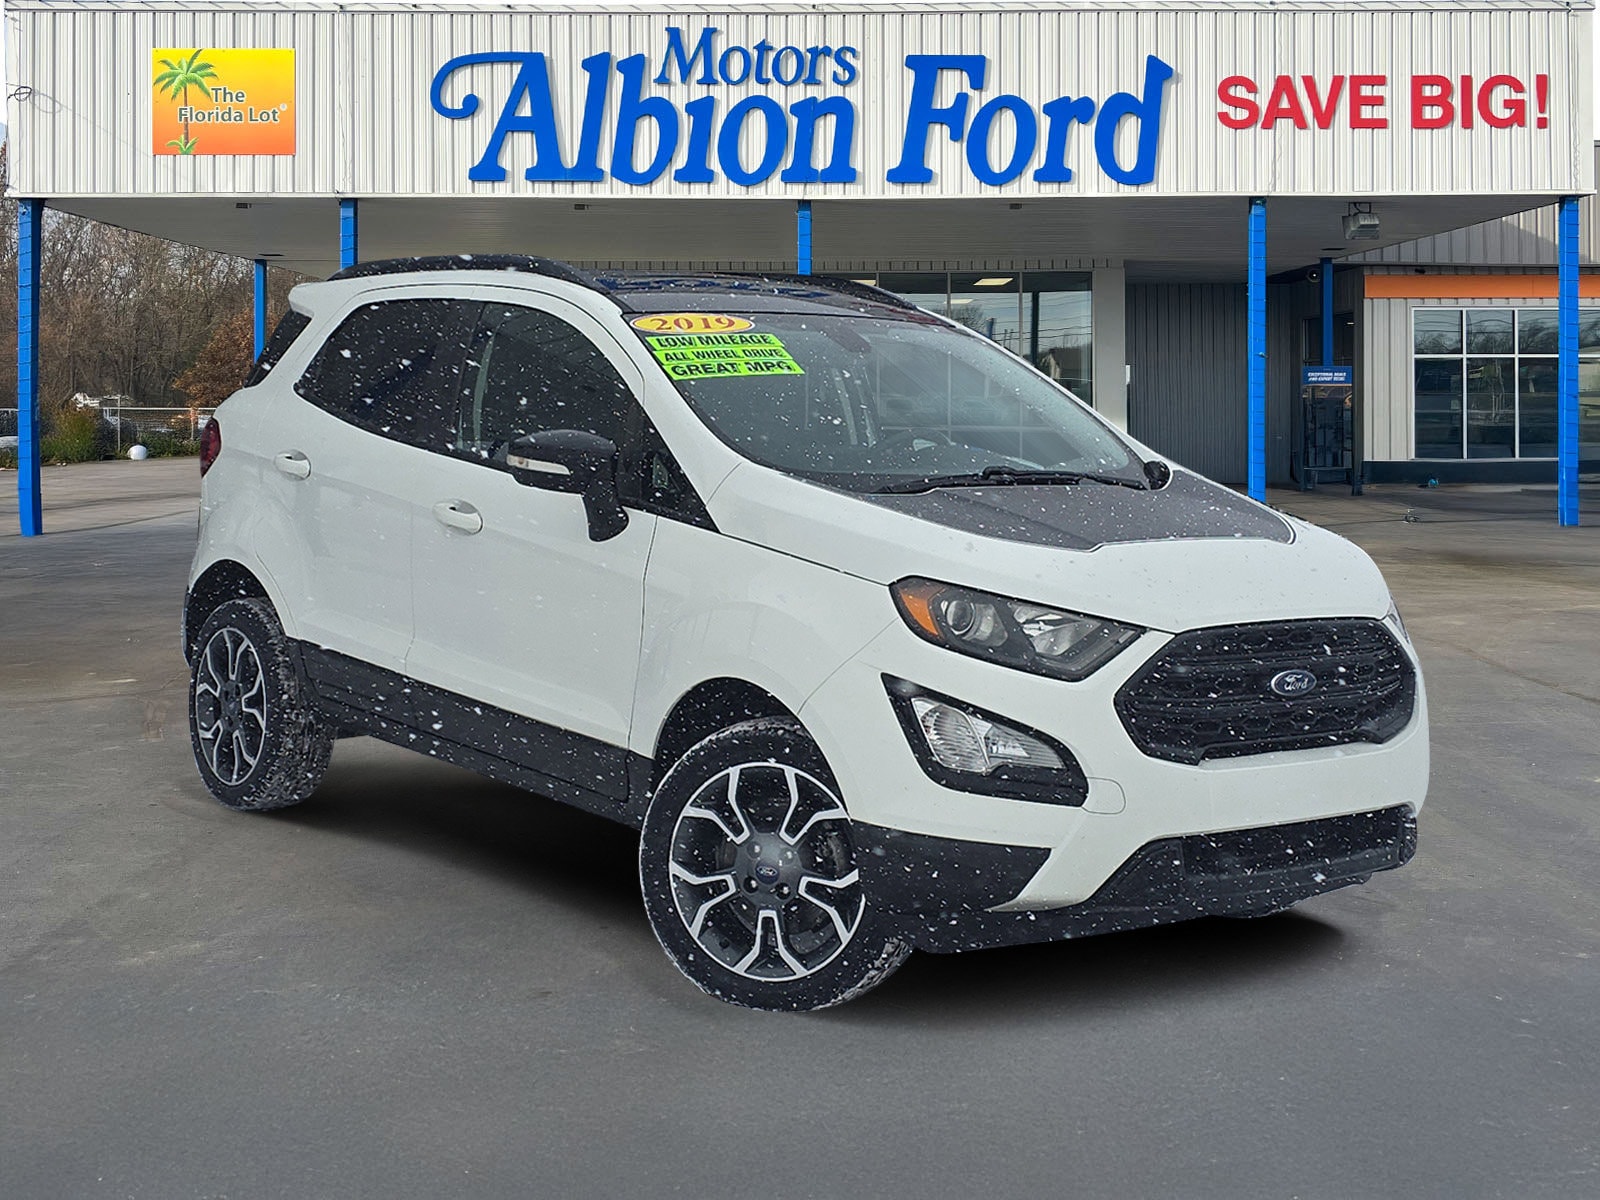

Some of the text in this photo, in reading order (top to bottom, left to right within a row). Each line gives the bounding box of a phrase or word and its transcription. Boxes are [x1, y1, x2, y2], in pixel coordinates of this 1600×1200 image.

[655, 28, 856, 86] Motors
[210, 86, 246, 103] The
[1217, 75, 1548, 130] SAVE BIG!
[177, 106, 280, 123] Florida Lot
[431, 52, 1173, 186] Albion Ford
[650, 317, 736, 331] 2019
[656, 333, 771, 348] LOW MILEAGE
[665, 348, 784, 362] ALL WHEEL DRIVE
[671, 360, 793, 377] GREAT MPG
[1284, 674, 1309, 691] Ford
